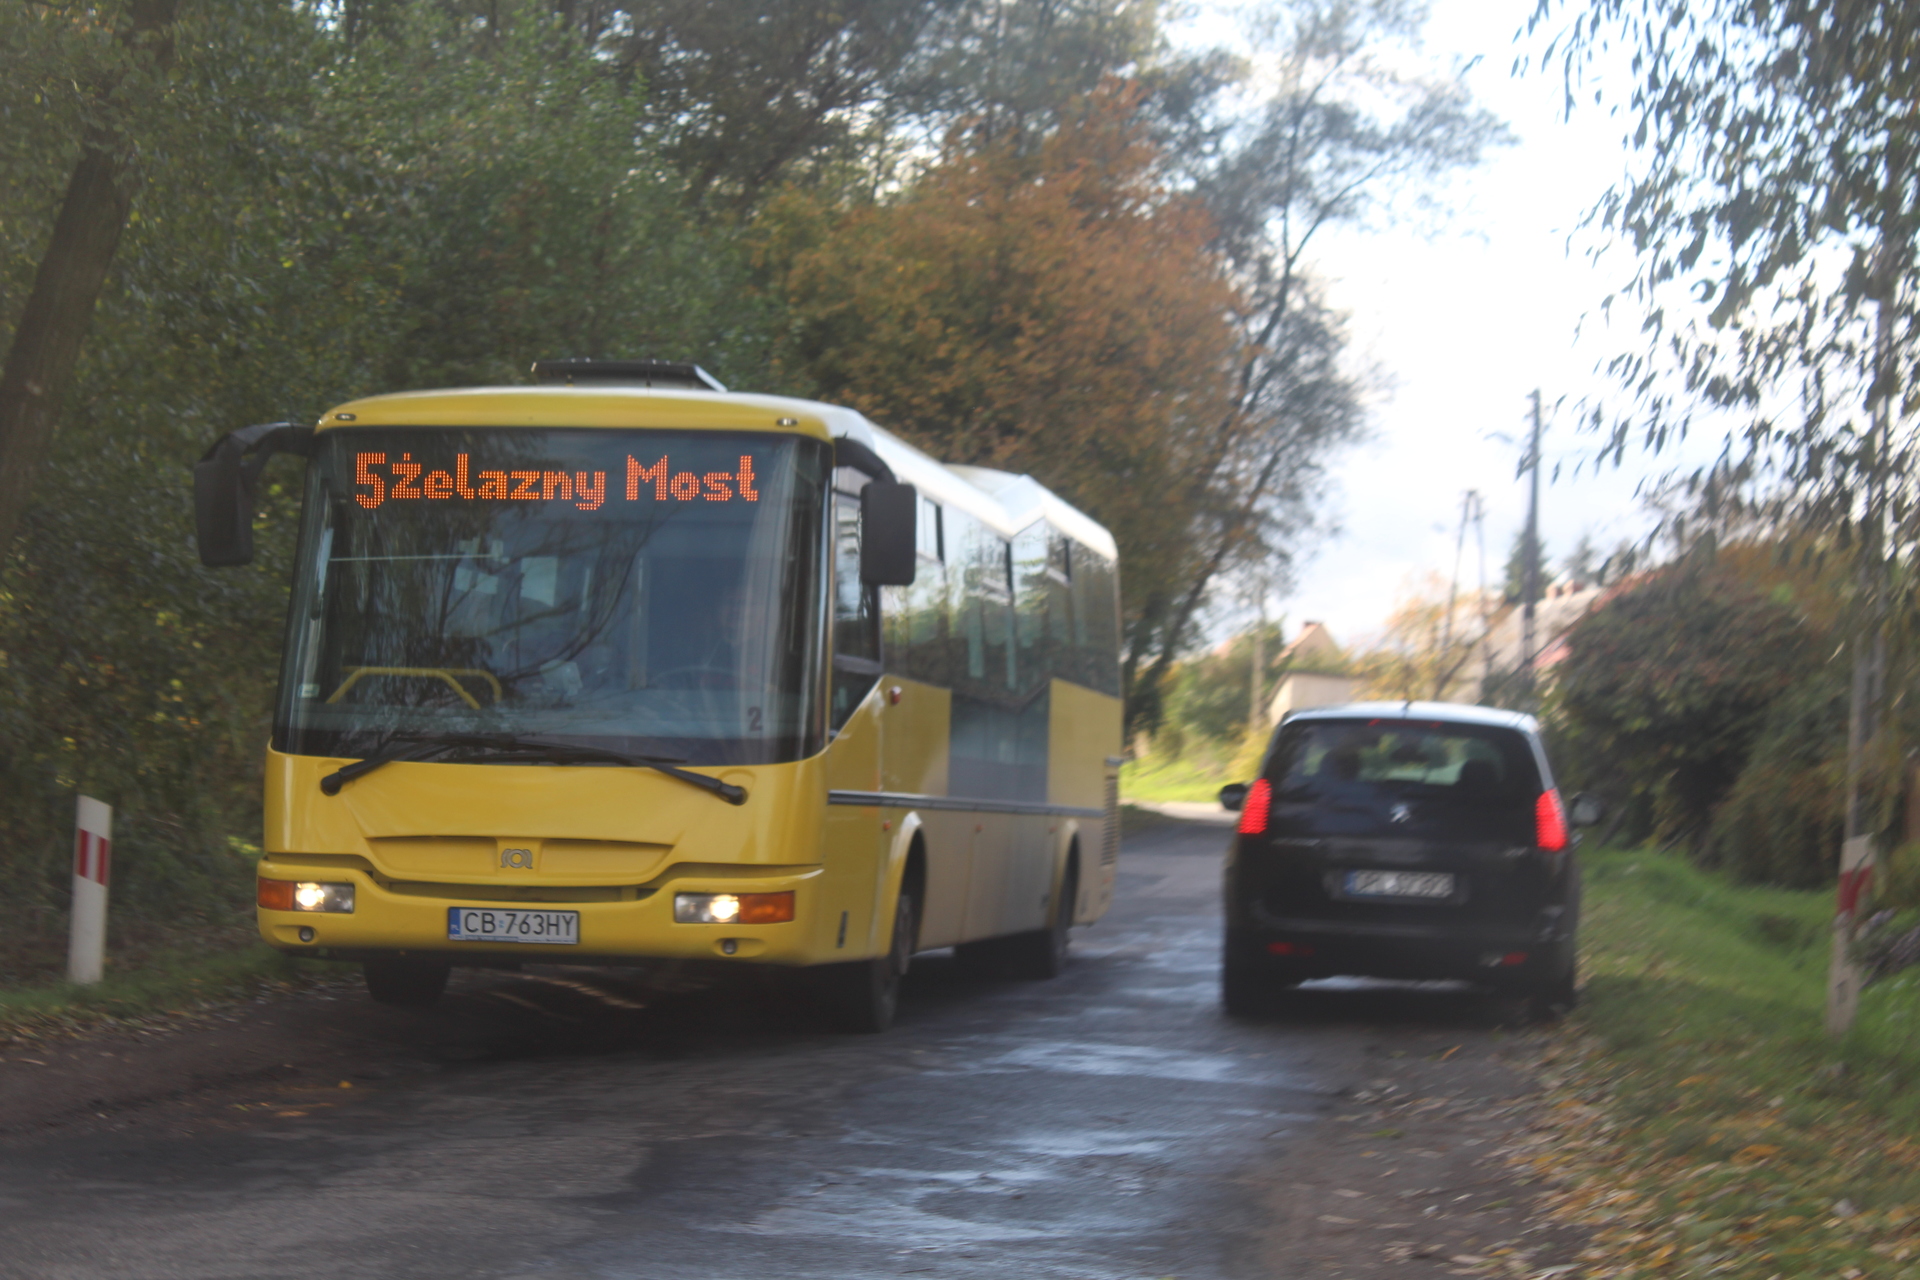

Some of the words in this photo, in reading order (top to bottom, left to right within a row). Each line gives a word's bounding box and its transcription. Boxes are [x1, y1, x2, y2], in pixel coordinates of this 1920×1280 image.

[626, 454, 758, 501] Most
[748, 706, 763, 731] 2
[464, 912, 496, 933] CB
[505, 912, 575, 935] 763HY
